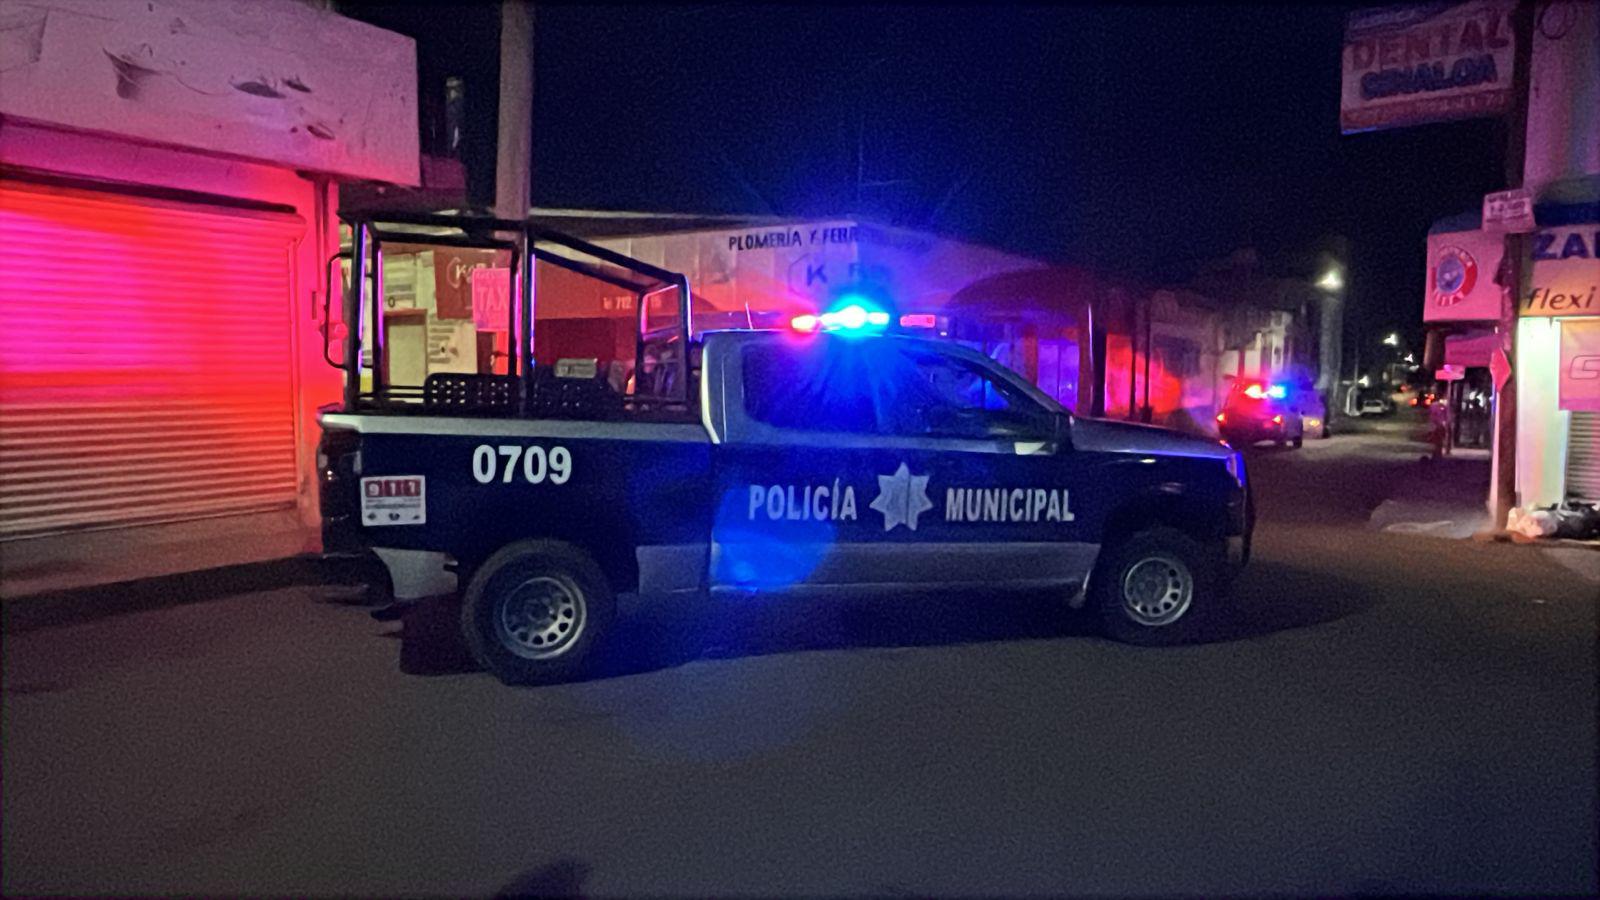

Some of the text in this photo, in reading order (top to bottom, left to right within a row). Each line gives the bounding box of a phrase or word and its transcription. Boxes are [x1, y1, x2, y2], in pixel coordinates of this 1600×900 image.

[1353, 8, 1510, 69] DENTAL
[729, 228, 802, 251] PLOMERÍA
[1527, 285, 1597, 310] flexi
[472, 444, 572, 485] 0709
[368, 481, 416, 496] 911
[748, 477, 1075, 522] POLICÍA MUNICIPAL
